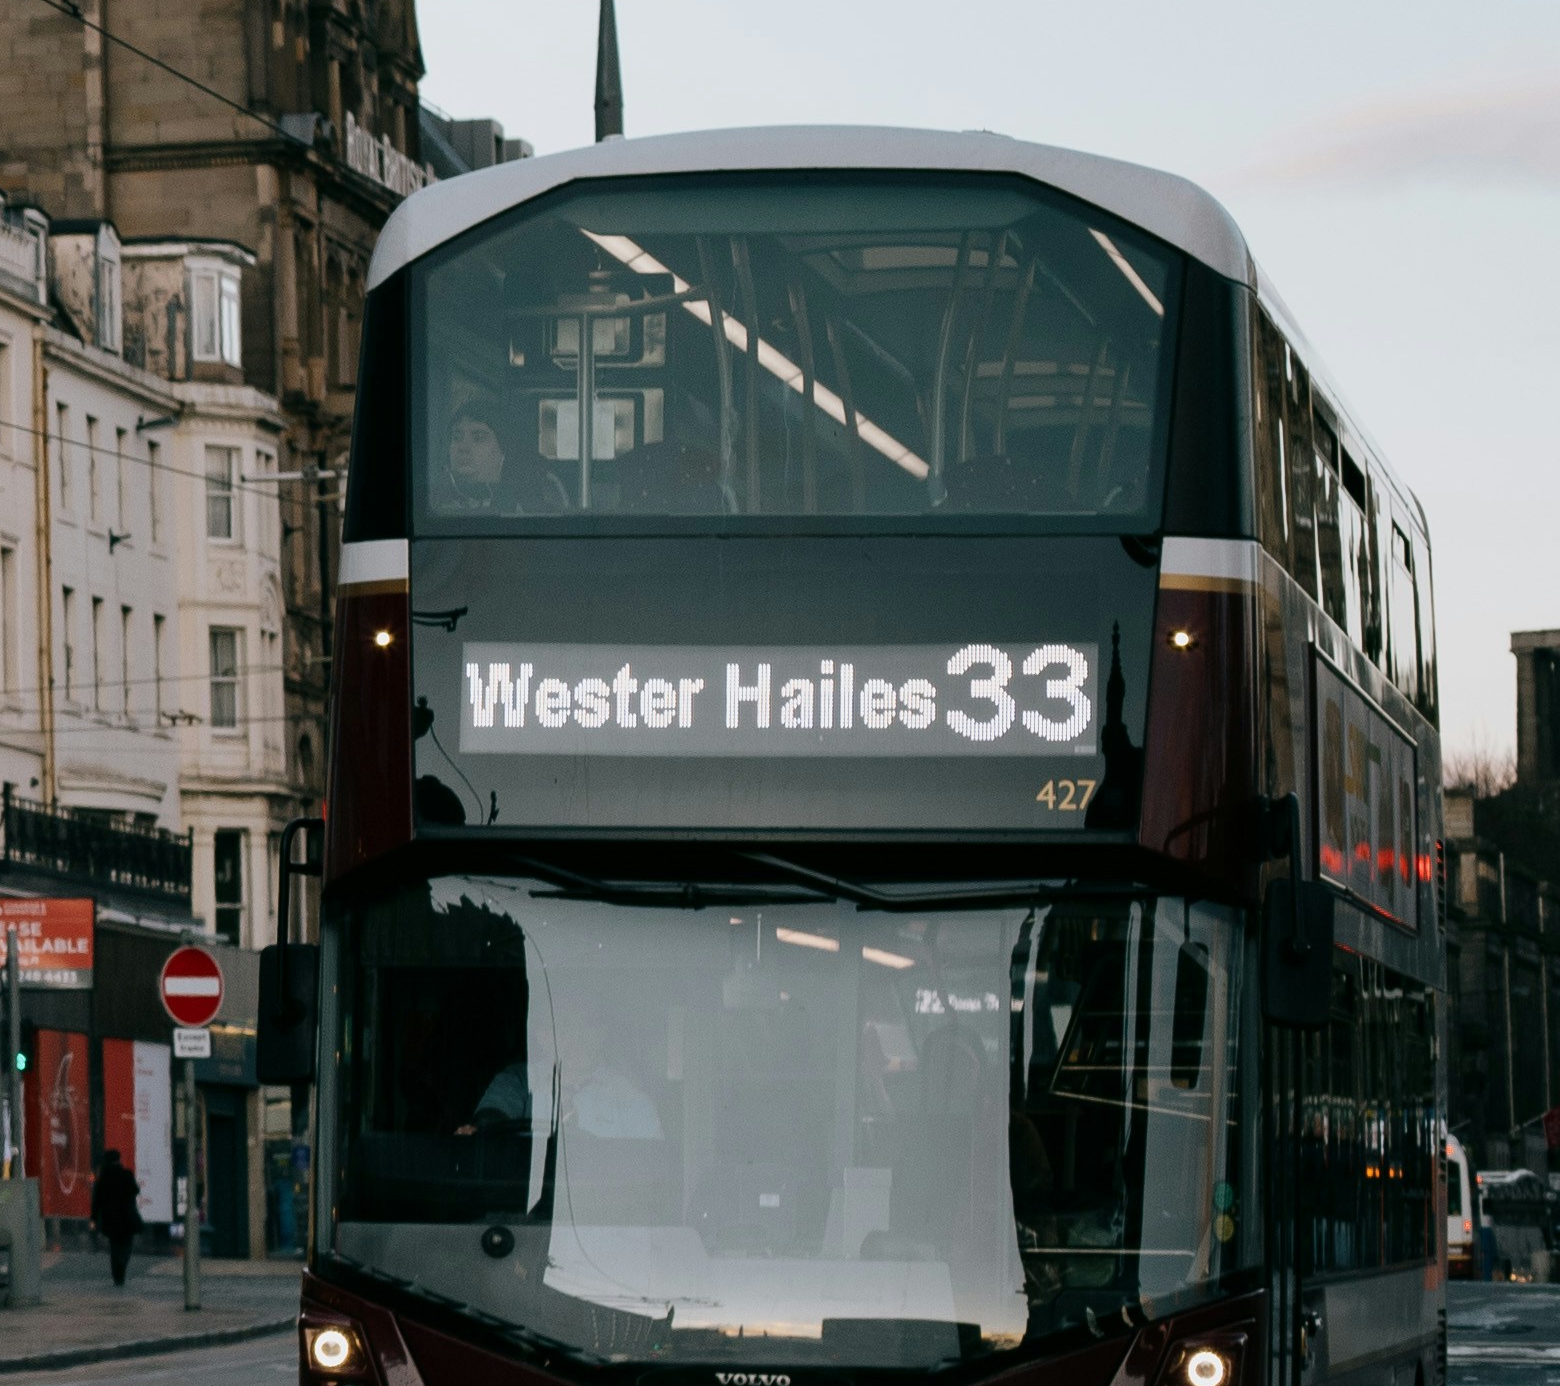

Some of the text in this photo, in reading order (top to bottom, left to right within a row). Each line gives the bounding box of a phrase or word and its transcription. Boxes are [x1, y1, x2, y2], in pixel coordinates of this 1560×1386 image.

[467, 644, 1092, 742] Wester Hailes 33
[1036, 779, 1097, 810] 427
